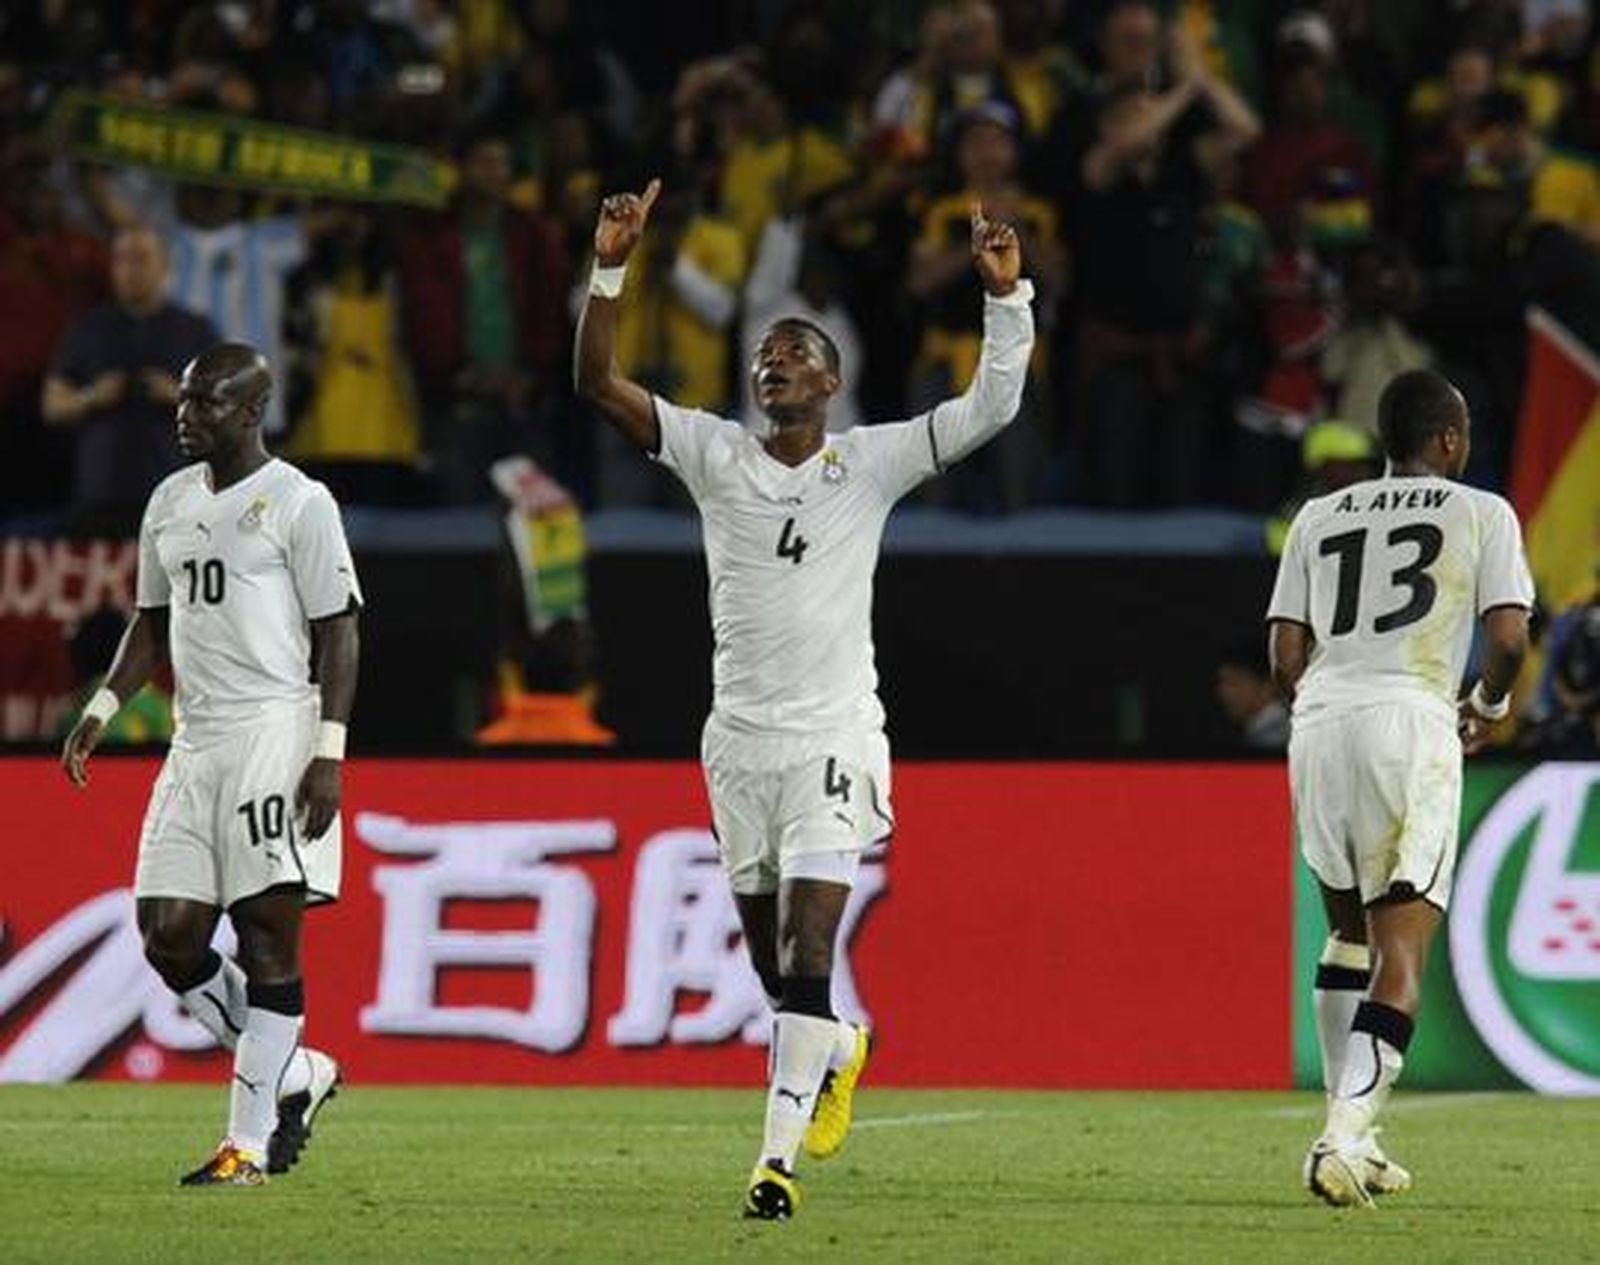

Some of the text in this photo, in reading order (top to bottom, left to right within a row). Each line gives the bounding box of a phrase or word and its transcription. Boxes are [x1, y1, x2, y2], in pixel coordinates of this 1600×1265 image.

[1336, 488, 1451, 513] A. AYEW
[777, 517, 807, 564] 4
[182, 558, 226, 605] 10
[1318, 522, 1444, 637] 13
[824, 757, 851, 802] 4
[237, 795, 285, 846] 10
